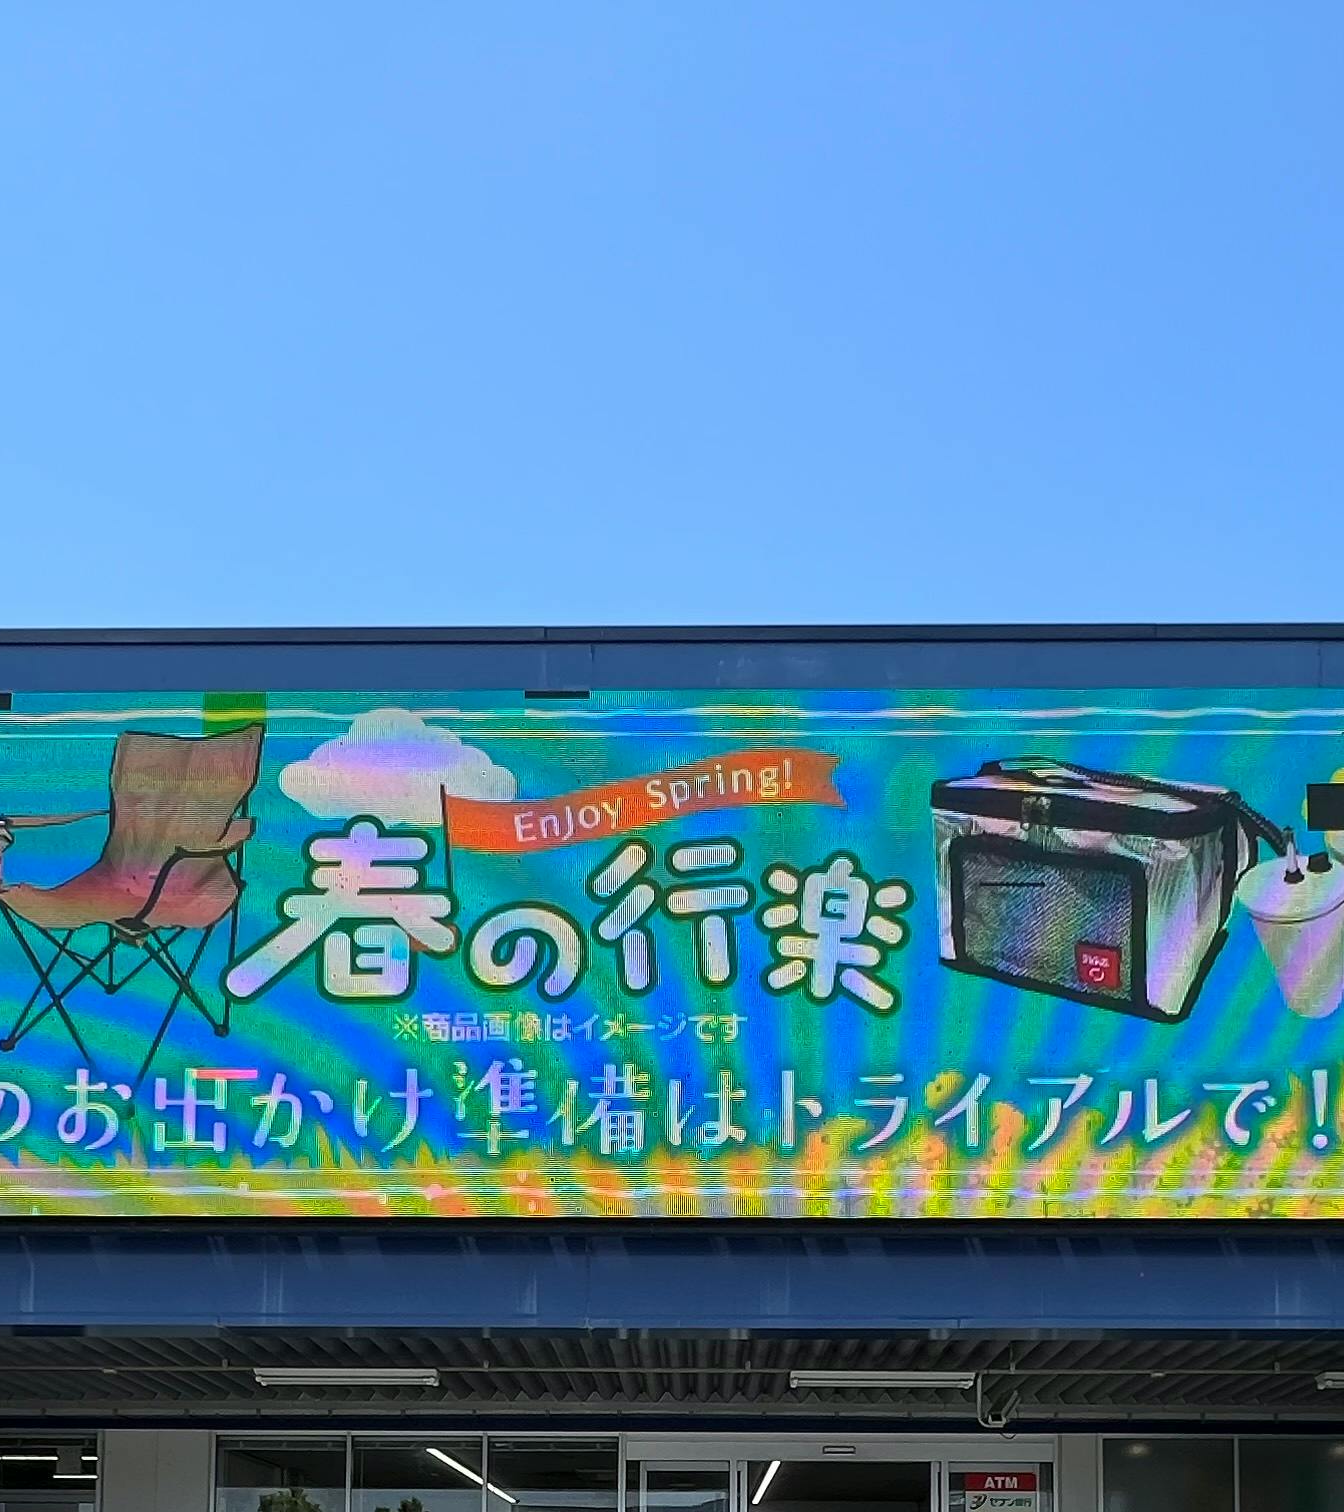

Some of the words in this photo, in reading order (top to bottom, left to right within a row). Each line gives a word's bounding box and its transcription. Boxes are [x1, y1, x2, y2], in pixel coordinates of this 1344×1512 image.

[644, 757, 794, 811] Spring!
[220, 814, 913, 1014] 春の行楽
[983, 1476, 1018, 1489] ATM
